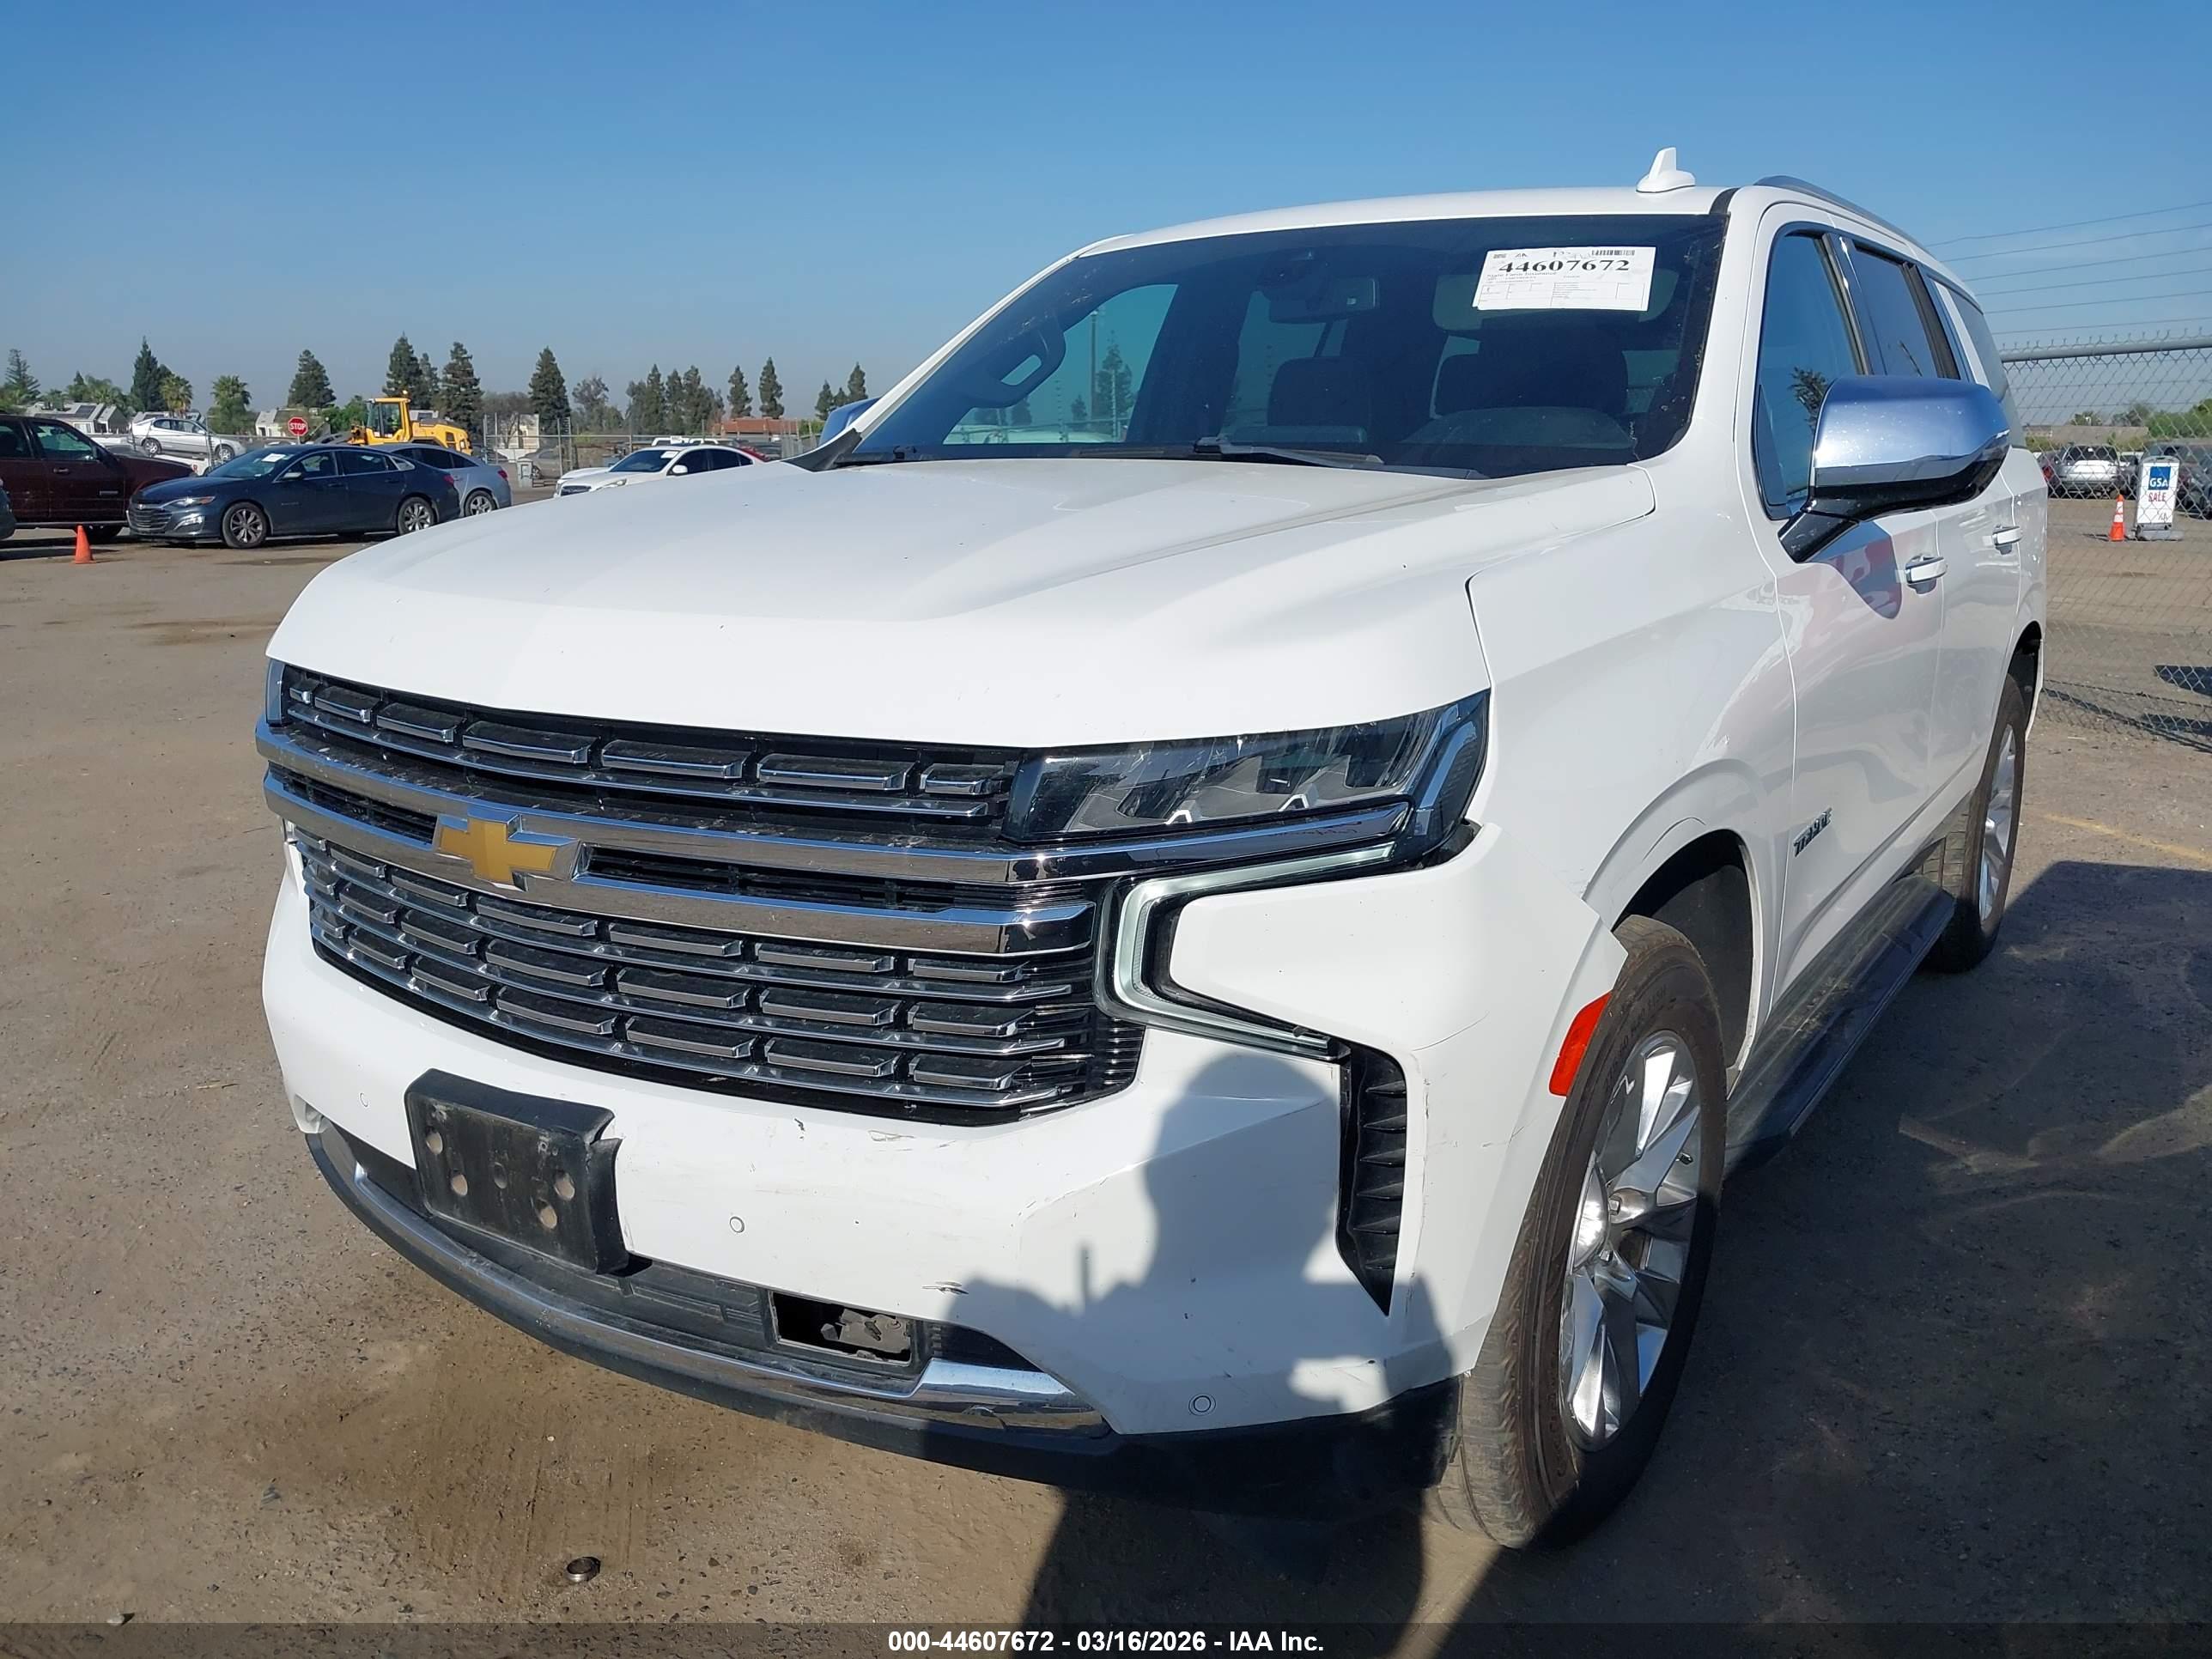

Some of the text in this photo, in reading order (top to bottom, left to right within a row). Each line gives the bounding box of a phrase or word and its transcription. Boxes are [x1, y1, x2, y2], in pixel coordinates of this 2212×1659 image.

[1498, 259, 1630, 273] 44607672
[2149, 477, 2169, 488] GSA
[2148, 492, 2166, 502] SALE
